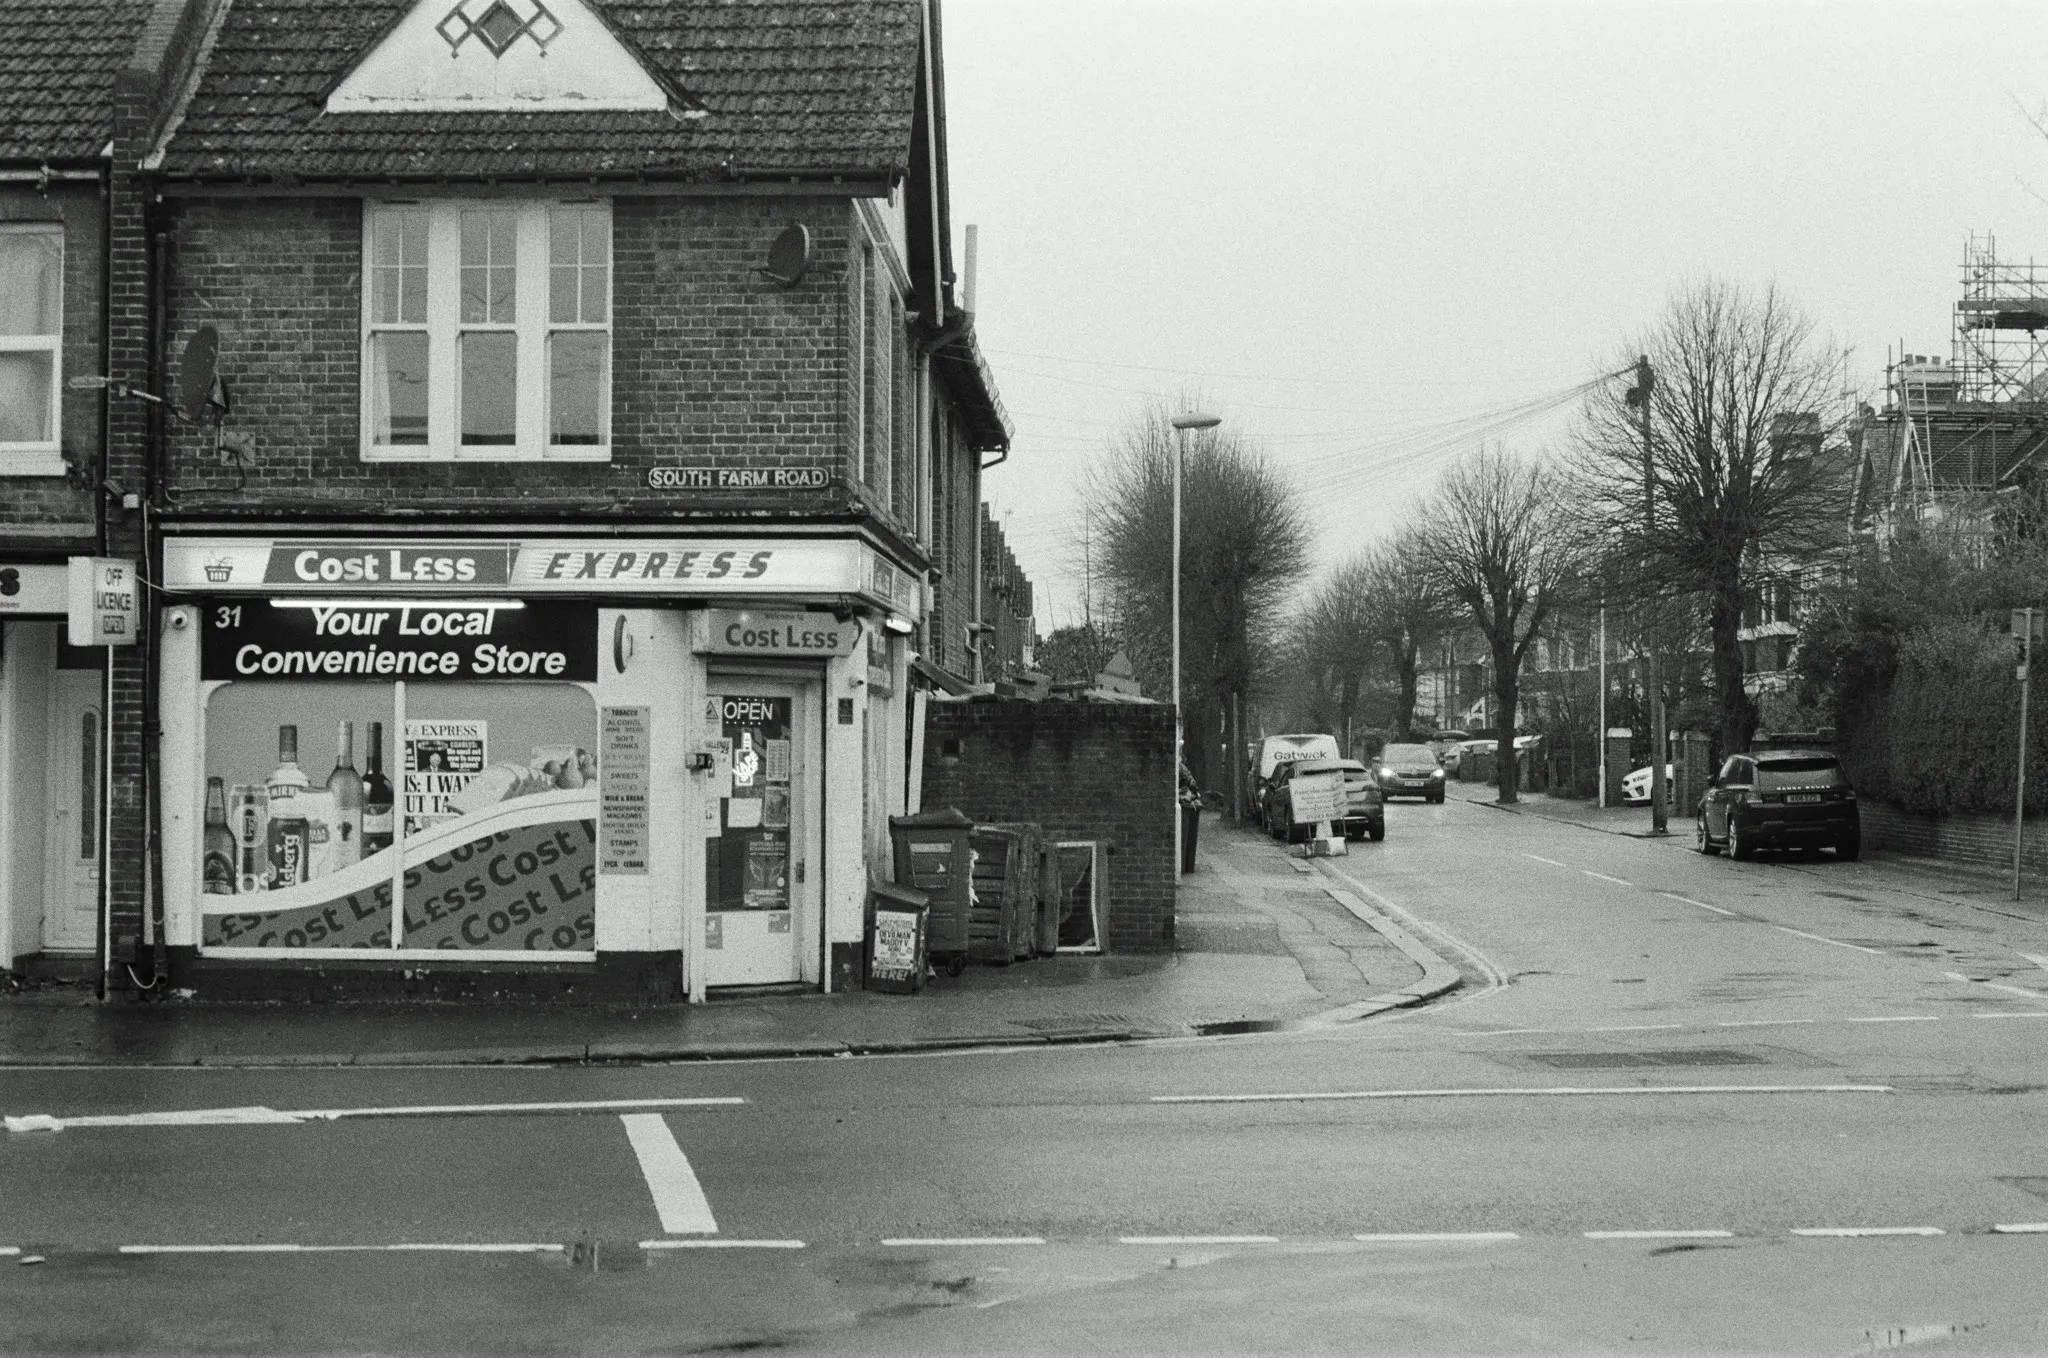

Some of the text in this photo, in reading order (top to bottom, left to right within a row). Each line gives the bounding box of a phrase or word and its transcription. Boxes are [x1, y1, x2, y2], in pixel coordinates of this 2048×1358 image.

[652, 470, 824, 487] SOUTH FARM ROAD
[105, 567, 123, 586] OFF
[294, 550, 379, 581] Cost
[544, 551, 773, 579] EXPRESS
[96, 591, 131, 611] LICENCE
[215, 605, 242, 629] 31
[311, 607, 495, 636] Your Local
[725, 623, 779, 647] Cost
[235, 643, 567, 675] Convenience Store
[724, 701, 773, 720] OPEN
[421, 725, 478, 736] EXPRESS
[607, 719, 641, 727] ALCOHOL
[1274, 750, 1328, 761] Gatwick
[488, 829, 578, 887] Cost
[460, 889, 549, 946] Cost
